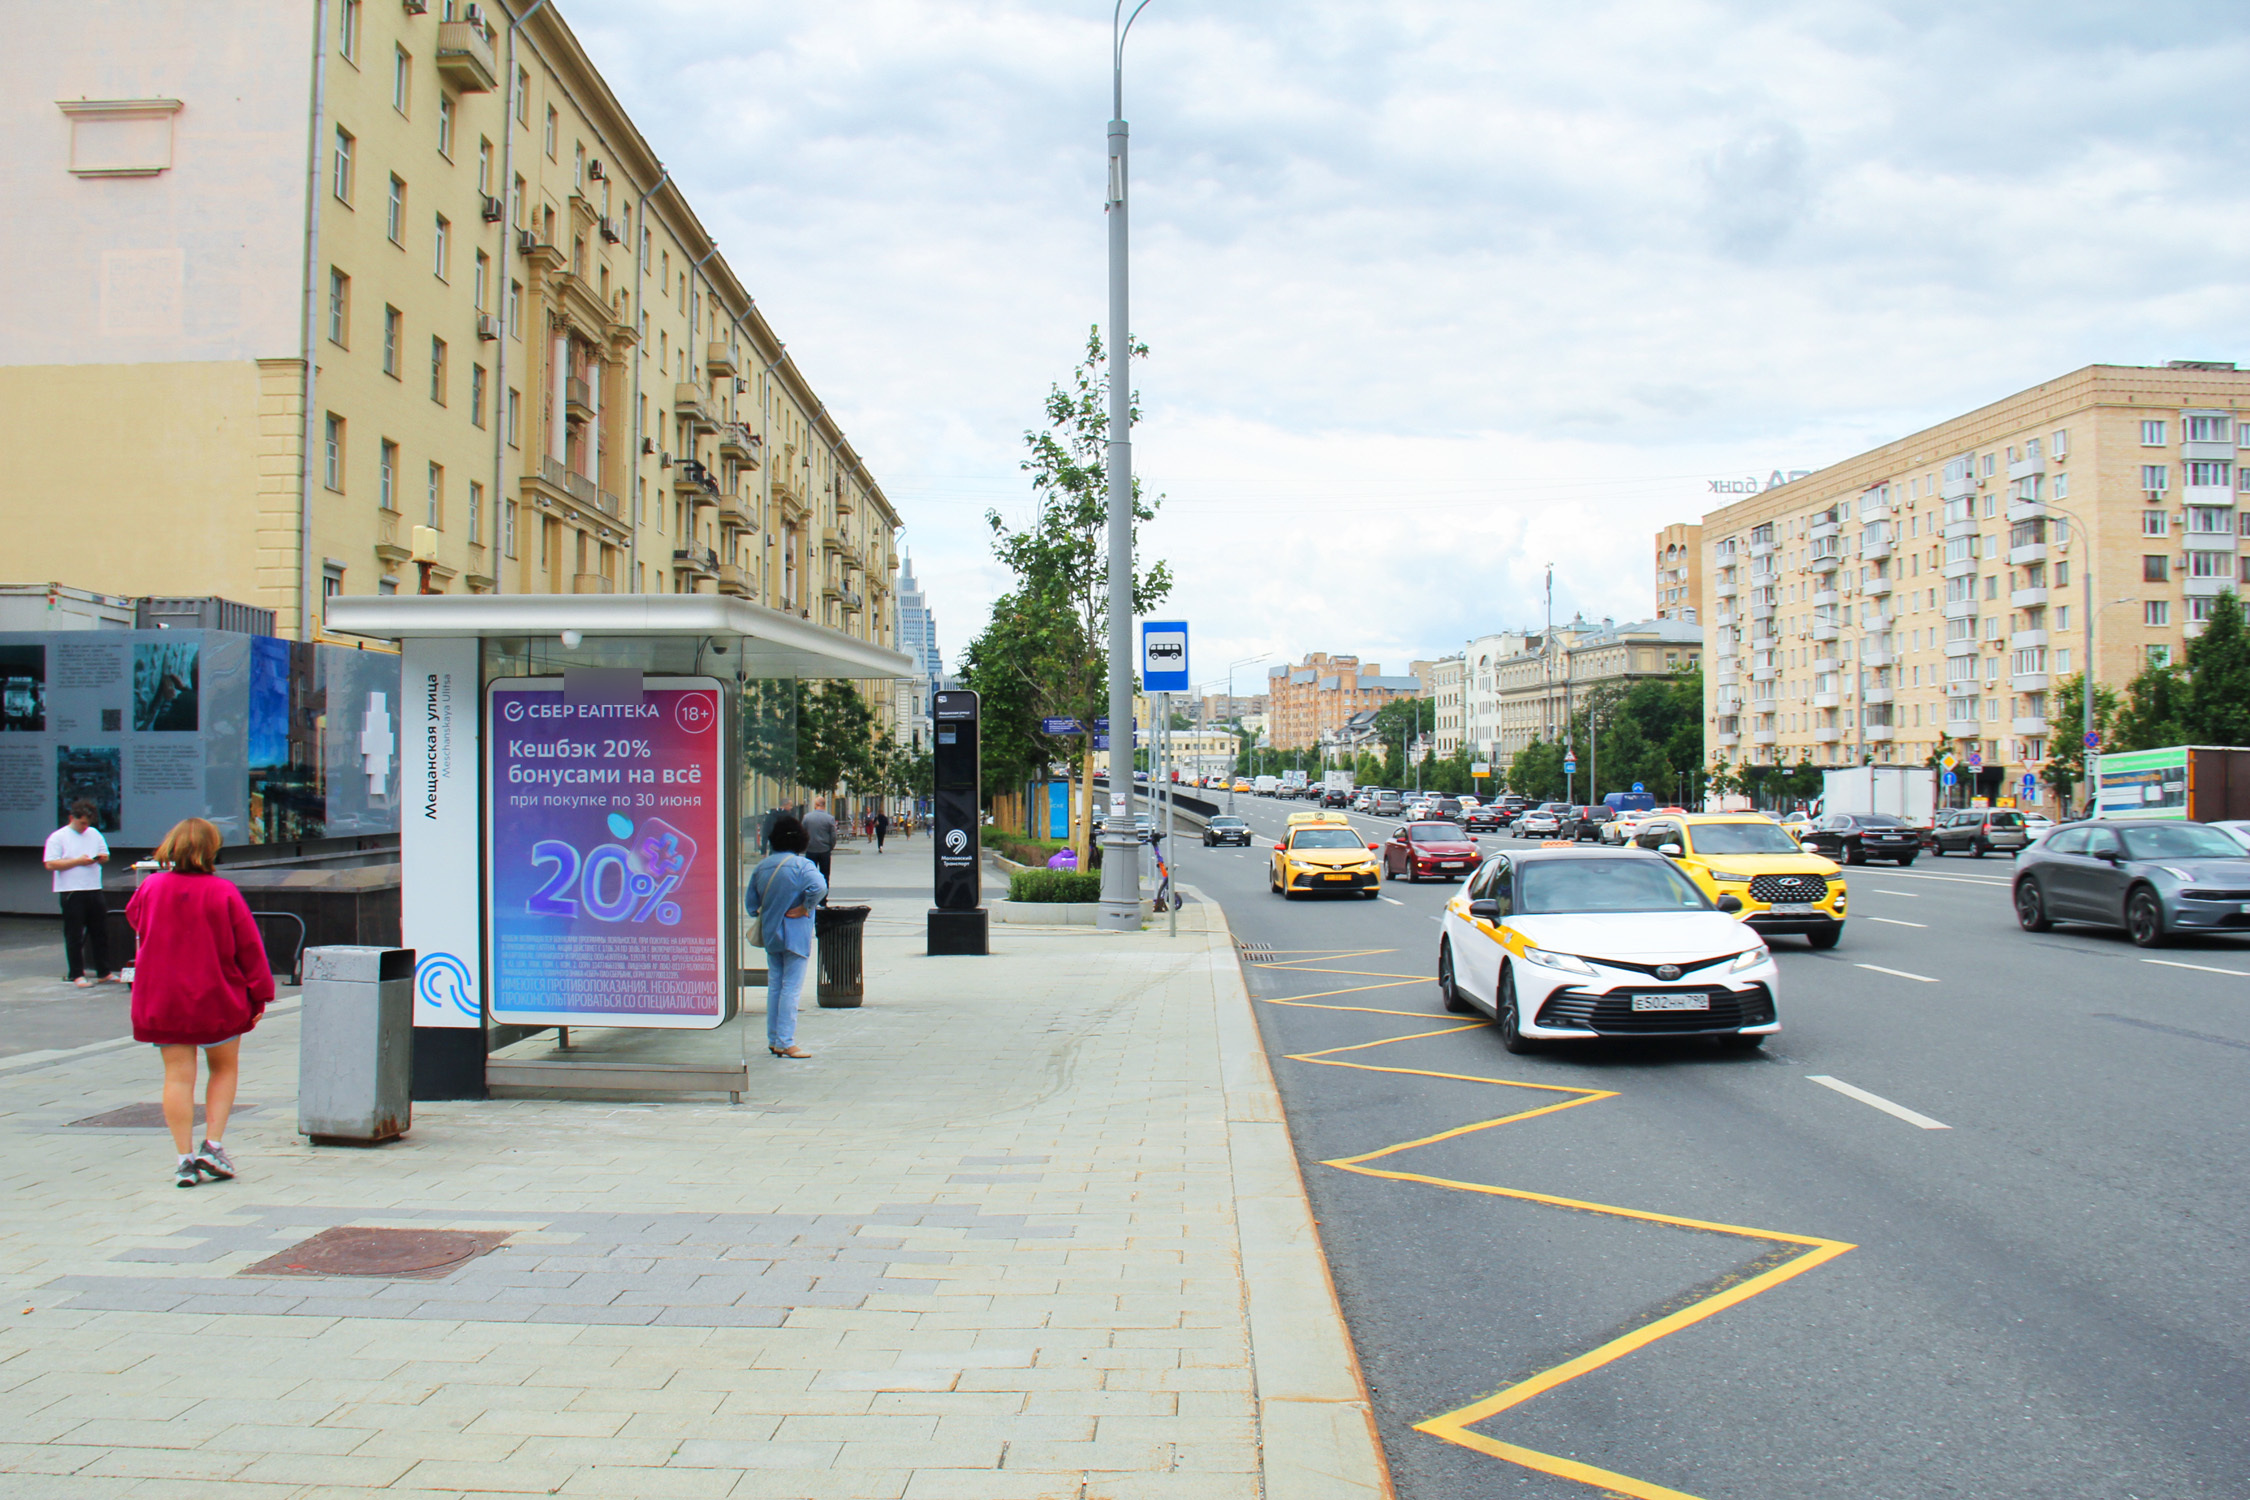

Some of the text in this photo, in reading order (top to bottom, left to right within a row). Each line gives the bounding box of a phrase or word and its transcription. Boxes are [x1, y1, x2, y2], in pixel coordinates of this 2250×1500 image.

[528, 704, 660, 718] СБЕР ЕАПТЕКА
[682, 707, 709, 721] 18+
[442, 674, 452, 779] Meschanskaya Ulitsa
[425, 674, 440, 820] Мещанская улица
[509, 739, 651, 758] Кешбэк 20%
[508, 764, 701, 787] бонусами на всё
[510, 793, 701, 808] при покупке по 30 июня
[525, 839, 682, 925] 20%
[502, 977, 716, 993] ИМЕЮТСЯ ПРОТИВОПОКАЗАНИЯ. НЕОБХОДИМО
[502, 991, 716, 1008] ПРОКОНСУЛЬТИРОВАТЬСЯ СО СПЕЦИАЛИСТОМ
